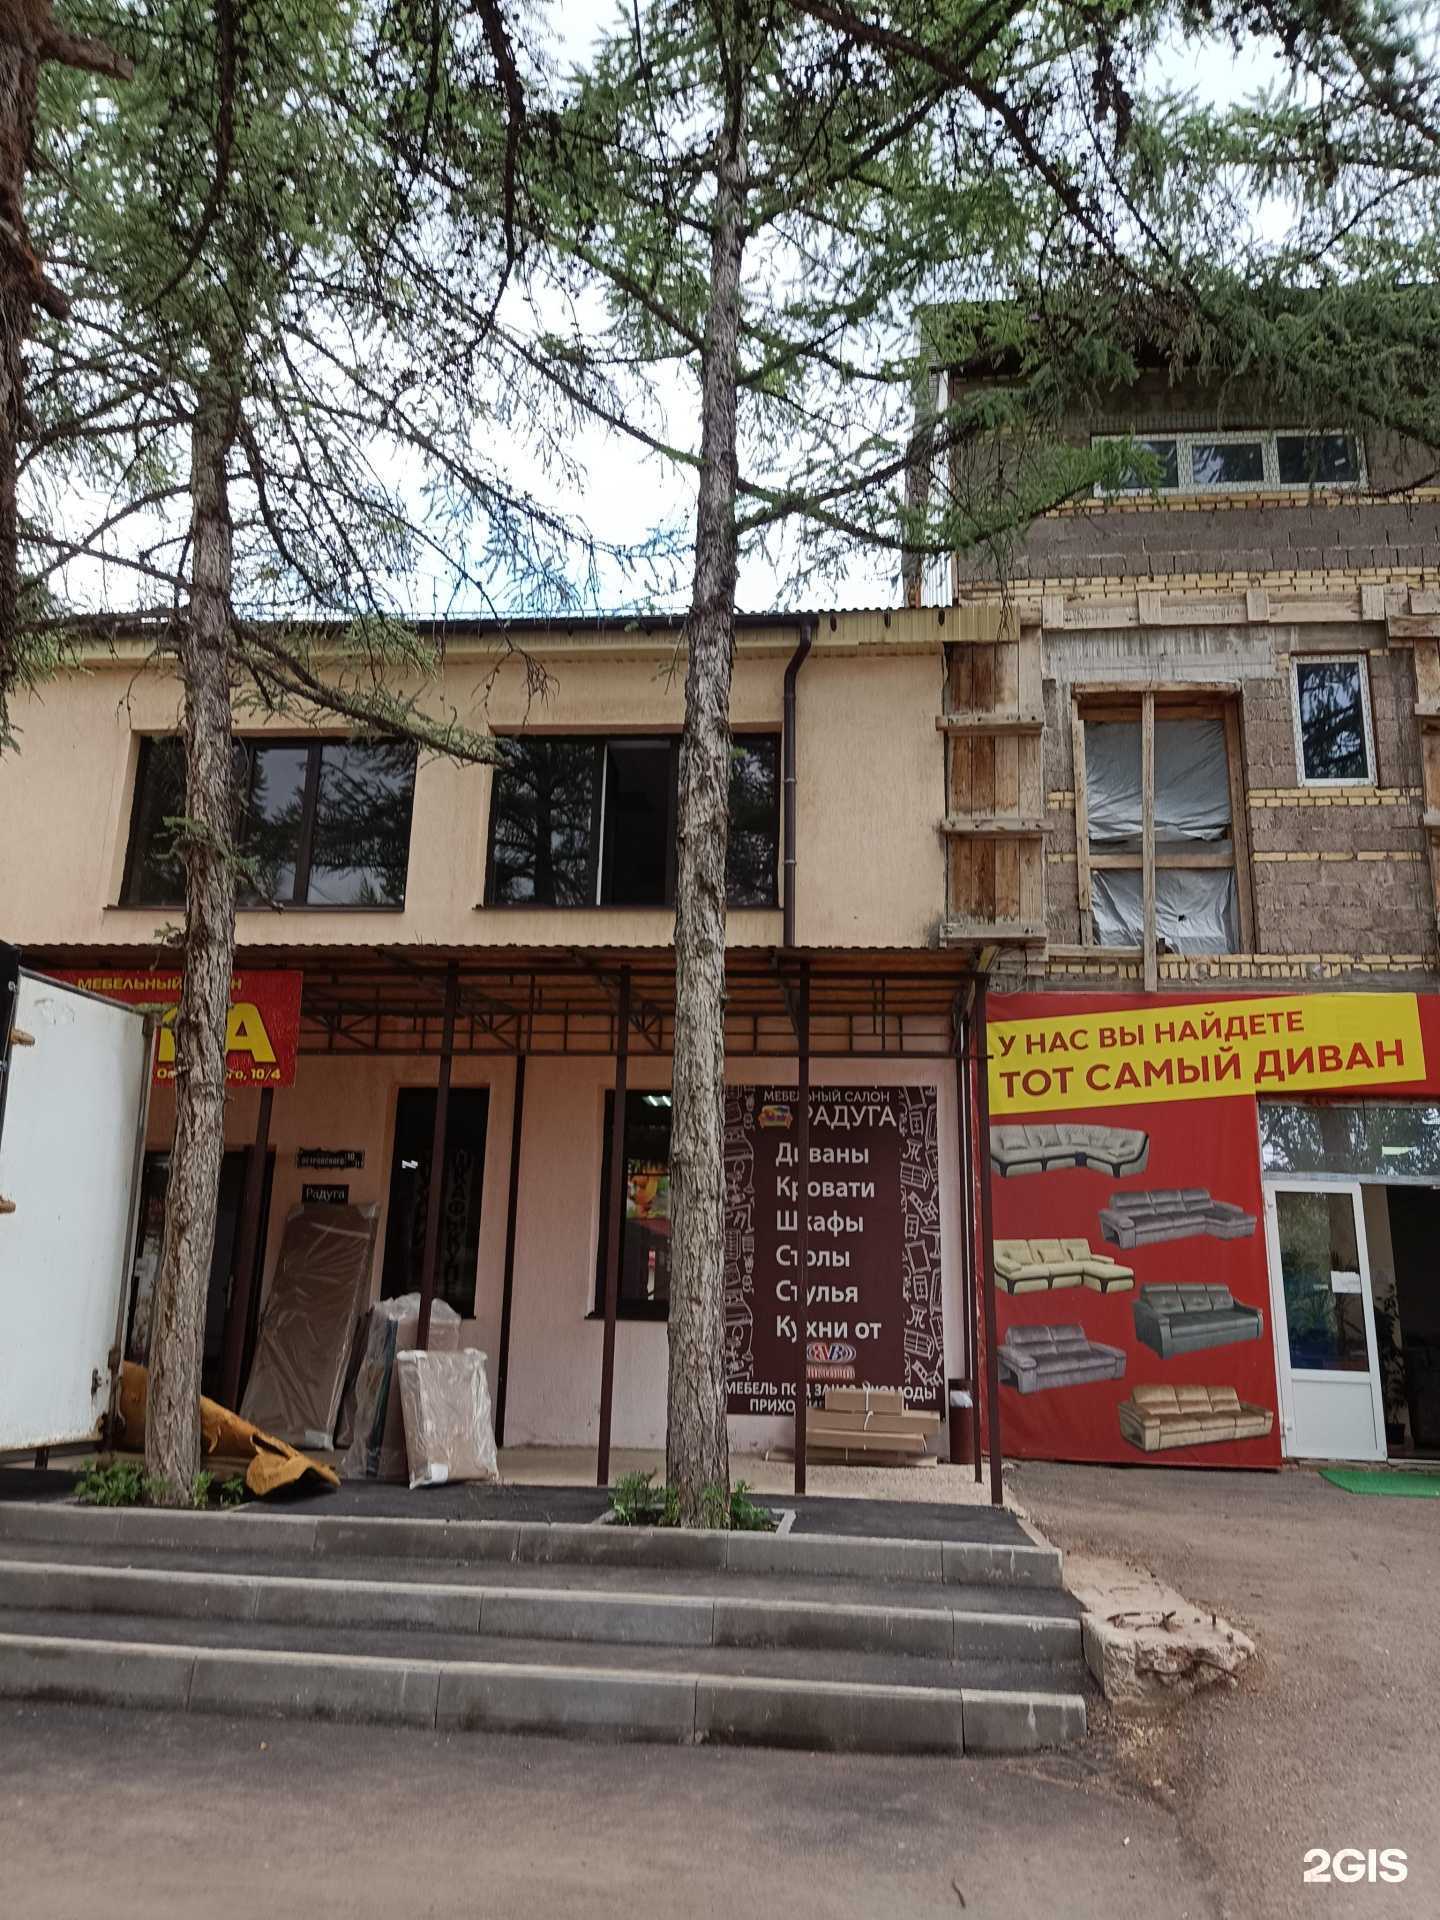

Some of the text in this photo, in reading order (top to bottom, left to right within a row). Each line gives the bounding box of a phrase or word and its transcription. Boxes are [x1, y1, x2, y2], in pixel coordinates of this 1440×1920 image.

[998, 1010, 1304, 1057] У НАС ВЫ НАЙДЕТЕ
[1000, 1039, 1405, 1098] ТОТ САМЫЙ ДИВАН
[845, 1091, 890, 1102] САЛОН
[306, 1187, 345, 1201] Радуга
[855, 1322, 882, 1340] от
